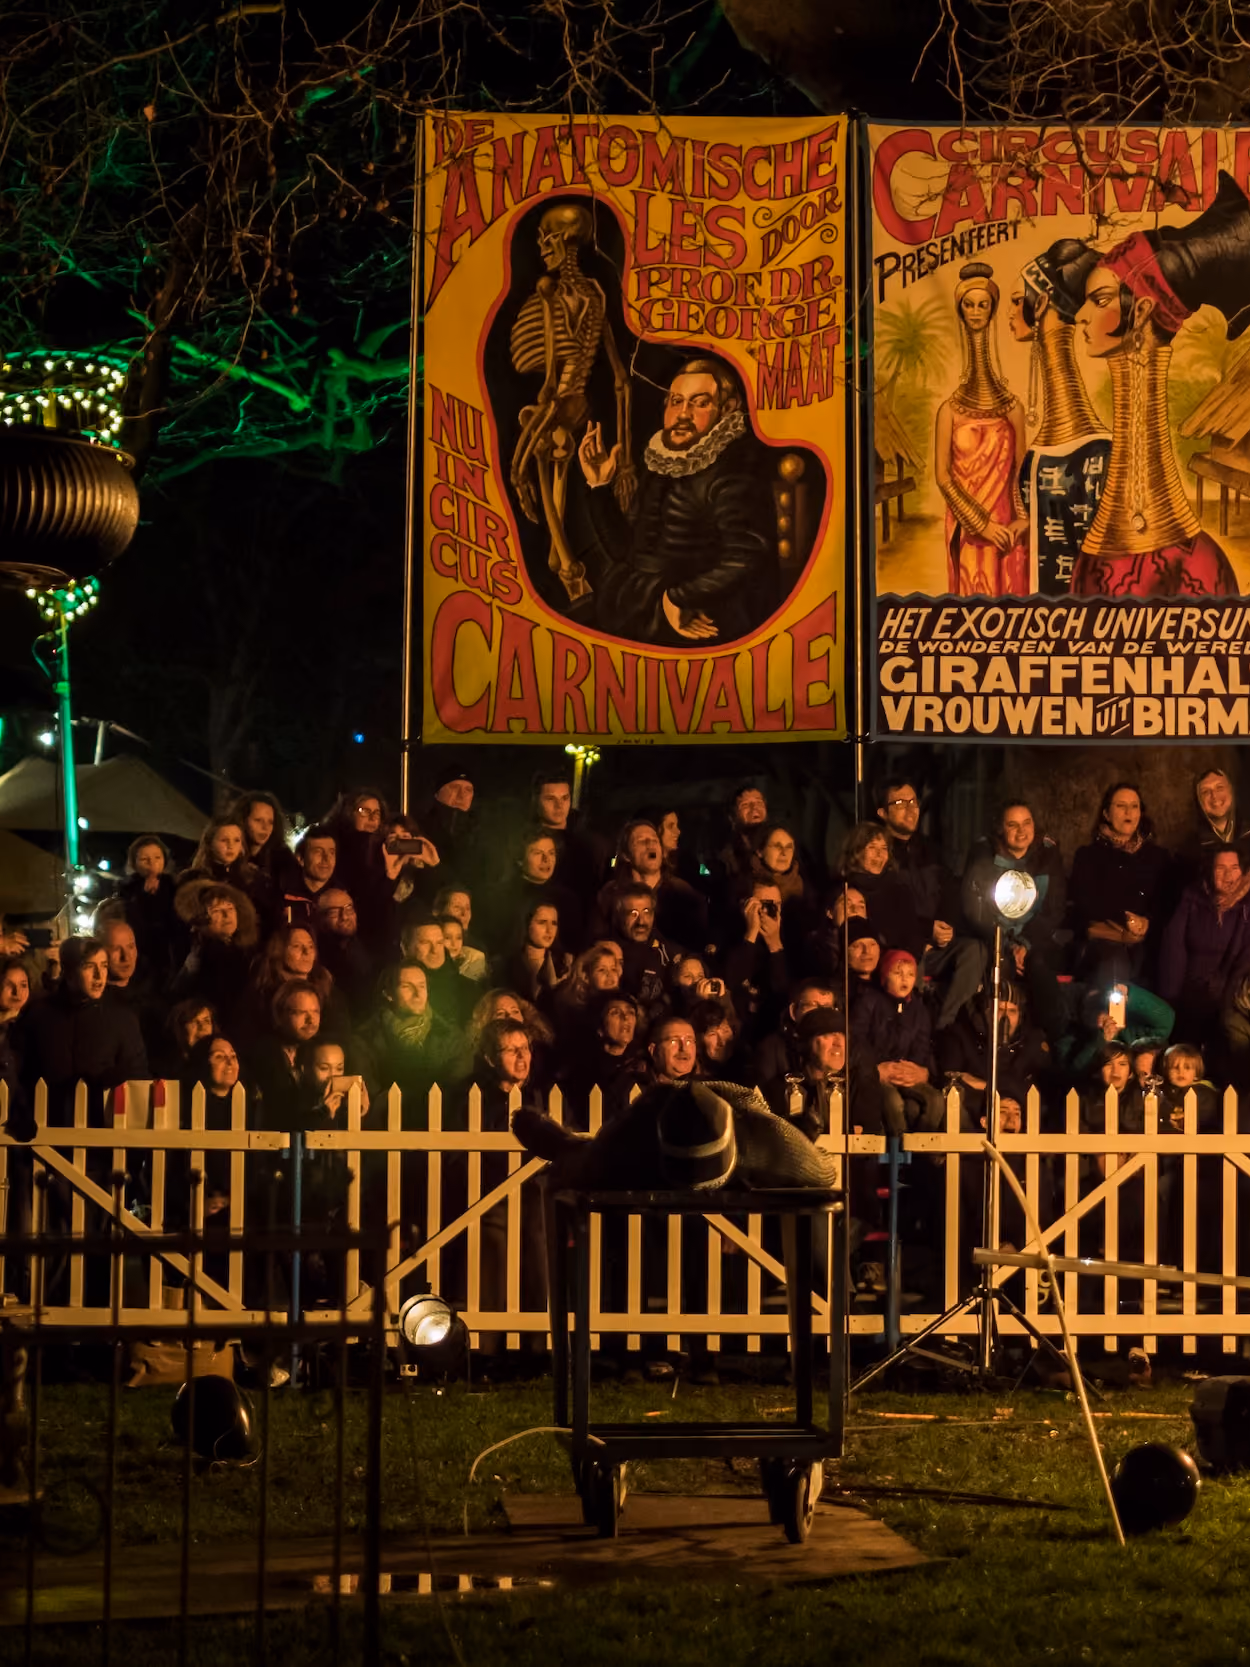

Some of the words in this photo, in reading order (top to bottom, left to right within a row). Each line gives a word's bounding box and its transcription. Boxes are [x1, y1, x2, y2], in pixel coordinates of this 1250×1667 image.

[432, 119, 495, 168] DE
[937, 129, 1160, 164] CIRCUS
[425, 121, 840, 315] ANATOMISCHE
[631, 190, 747, 269] LES
[760, 187, 843, 269] DOOR
[635, 267, 762, 306] PROF
[768, 255, 843, 306] DR.
[874, 221, 1021, 304] PRESENTEERT
[638, 292, 837, 341] GEORGE
[756, 324, 841, 410] MAAT
[428, 383, 485, 467] NU
[433, 445, 492, 506] IN
[878, 607, 932, 640] HET
[931, 607, 1088, 640] EXOTISCH
[879, 640, 912, 654] DE
[917, 640, 1056, 655] WONDEREN
[1068, 640, 1114, 655] VAN
[1122, 640, 1156, 655] DE
[430, 590, 838, 735] CARNIVALE
[880, 695, 1094, 736] VROUWEN
[1096, 697, 1131, 732] UIT
